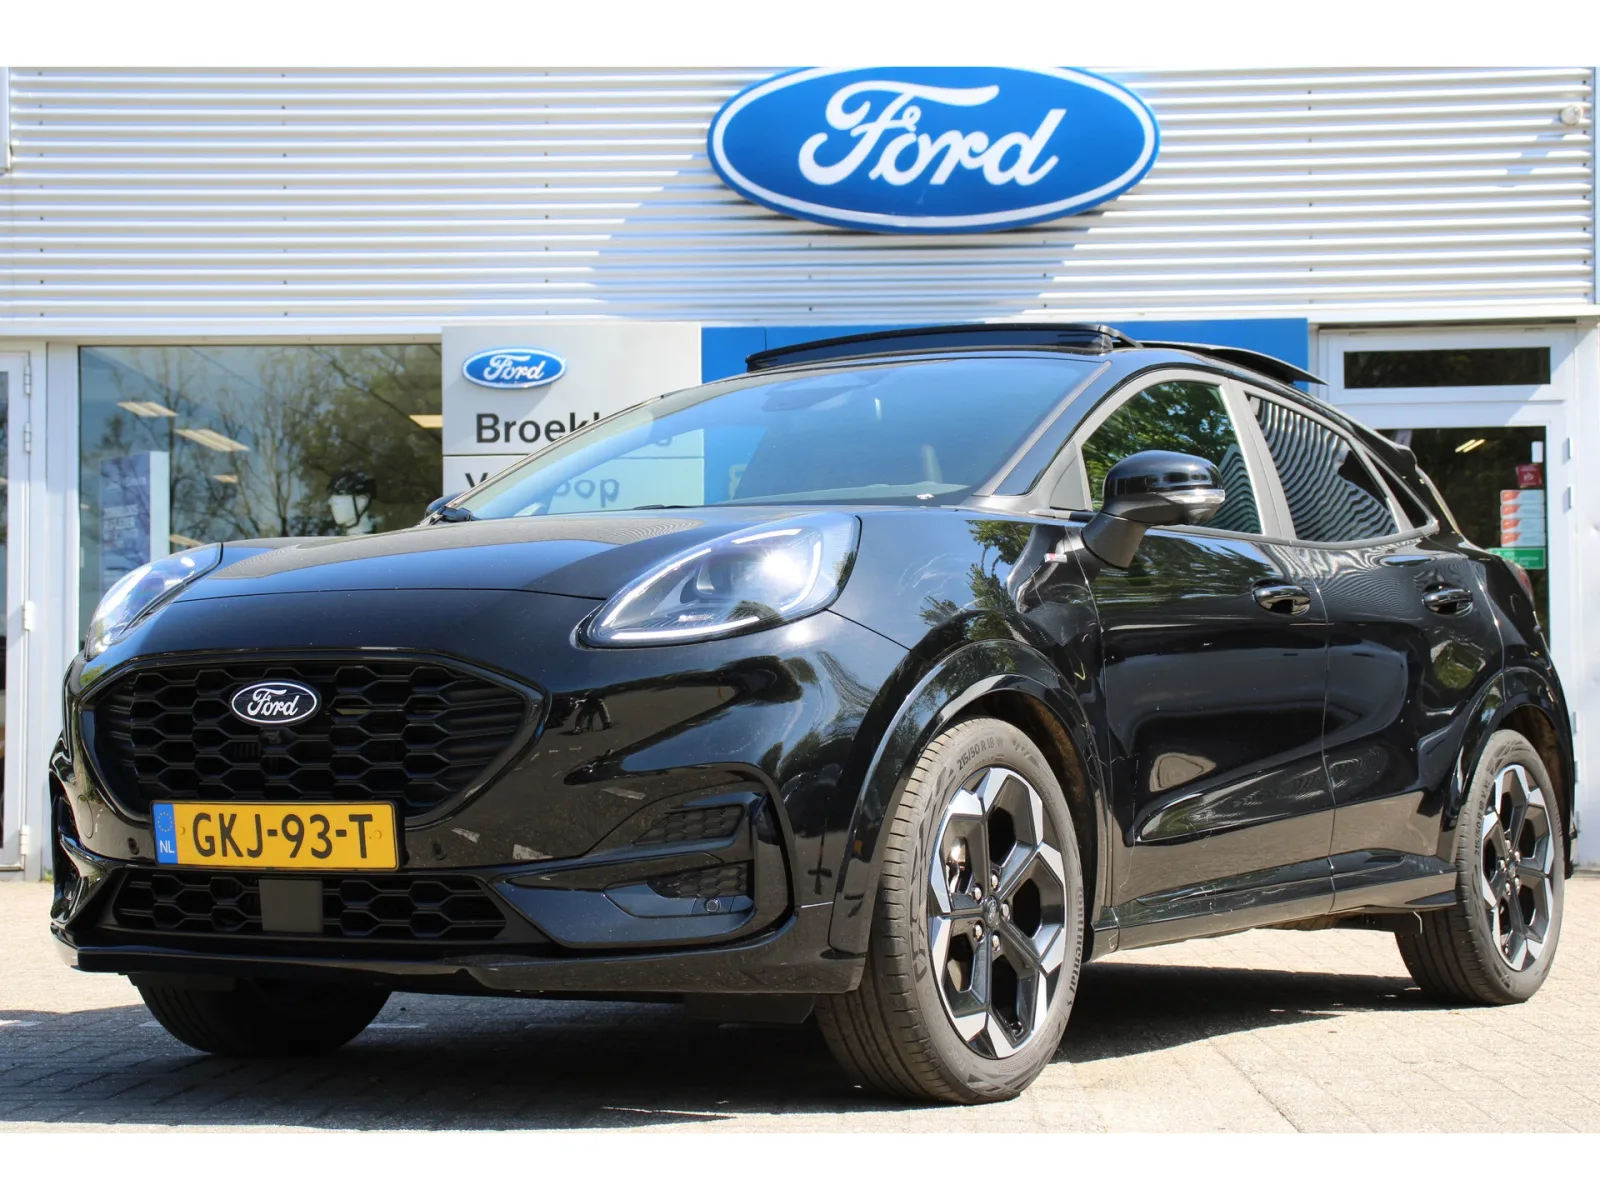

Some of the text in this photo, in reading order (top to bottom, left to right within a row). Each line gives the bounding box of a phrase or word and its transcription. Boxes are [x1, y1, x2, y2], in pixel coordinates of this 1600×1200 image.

[799, 80, 1067, 186] Ford
[483, 354, 547, 381] Ford
[247, 688, 300, 716] Ford
[160, 812, 373, 859] NL GKJ-93-T
